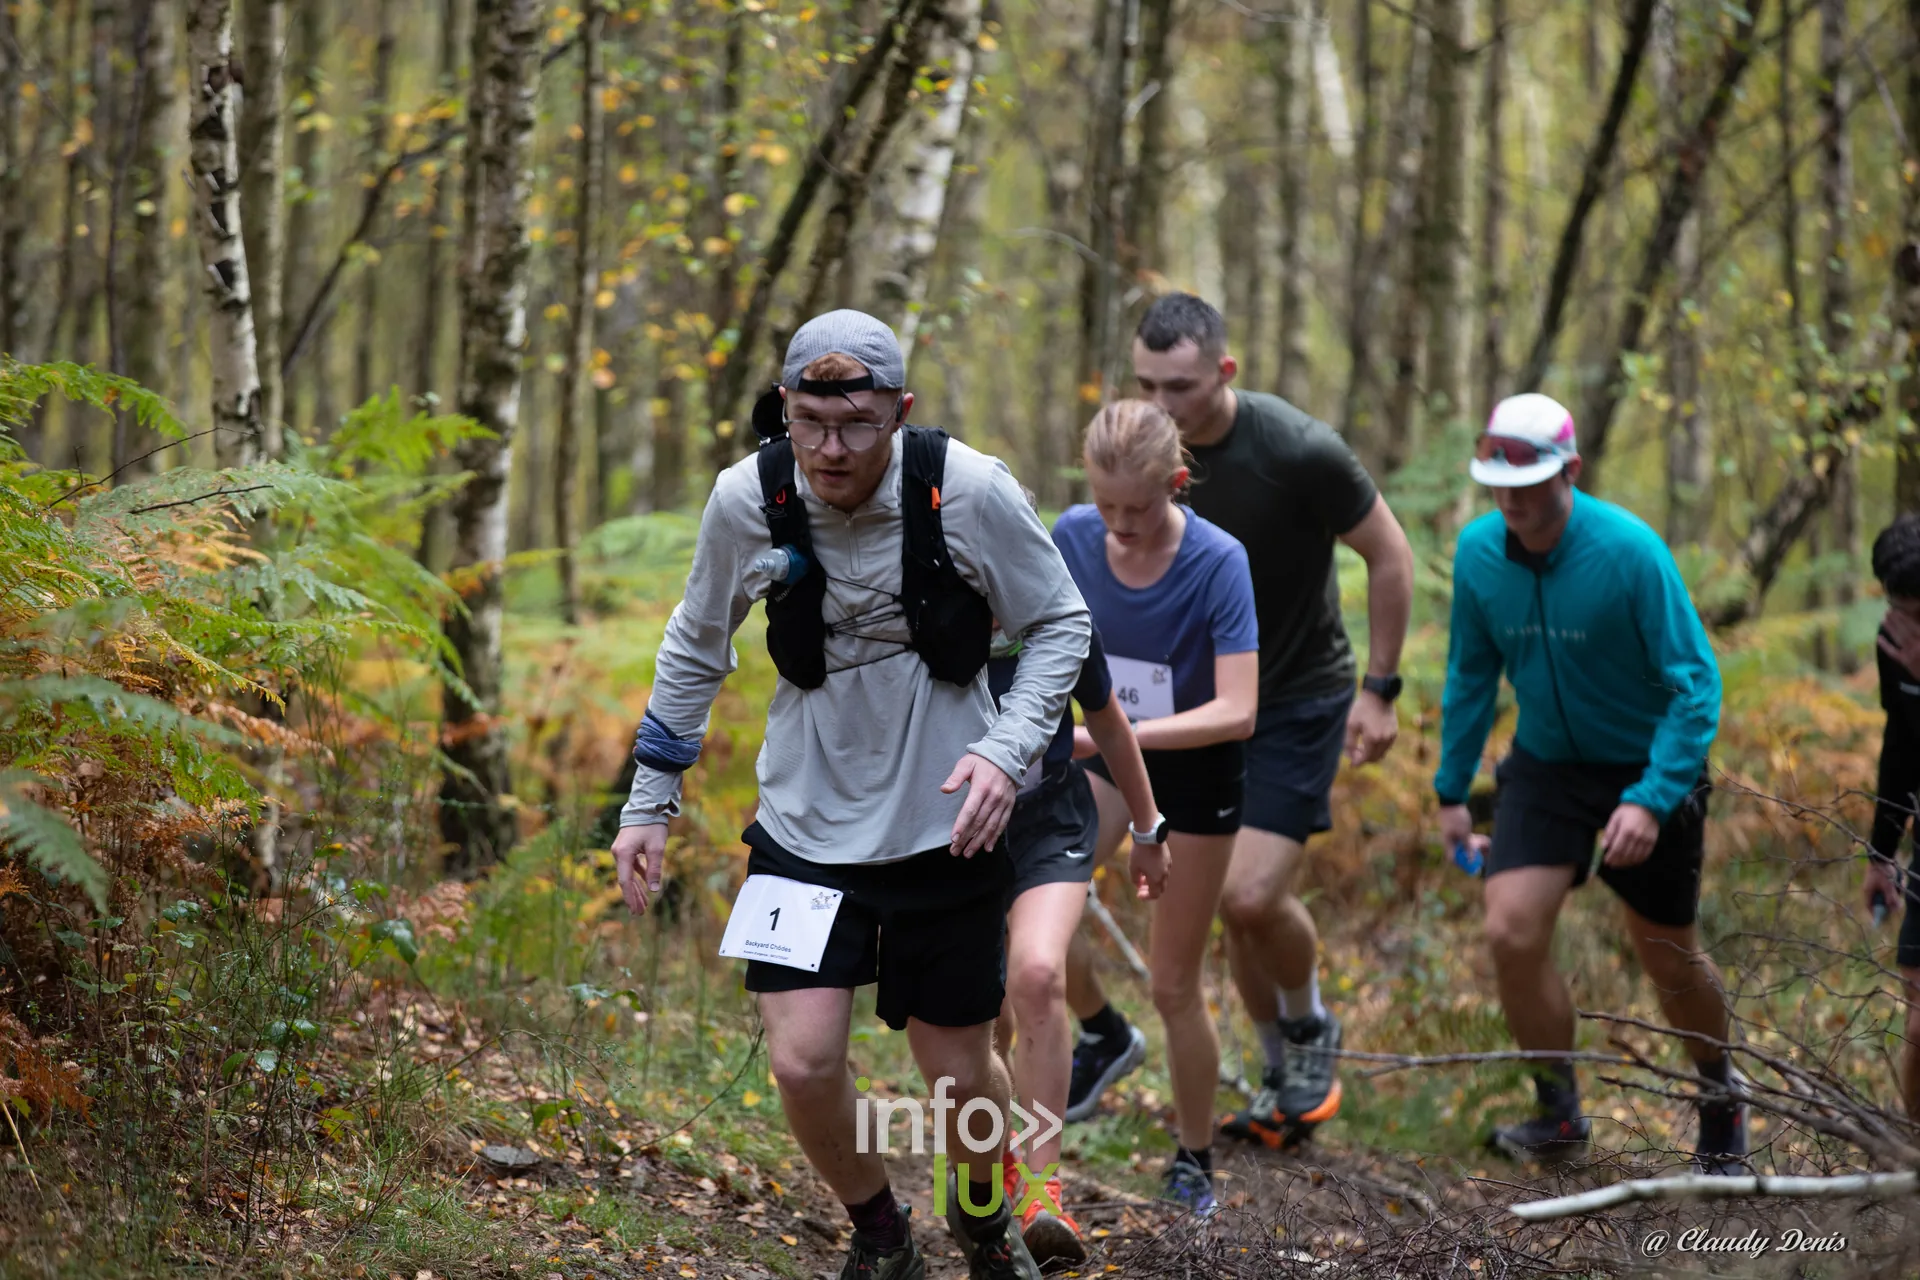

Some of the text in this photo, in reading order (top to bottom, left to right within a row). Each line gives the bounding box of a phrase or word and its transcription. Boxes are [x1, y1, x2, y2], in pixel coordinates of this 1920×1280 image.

[1118, 686, 1140, 705] 46
[769, 907, 781, 931] 1
[745, 940, 770, 949] Backyard
